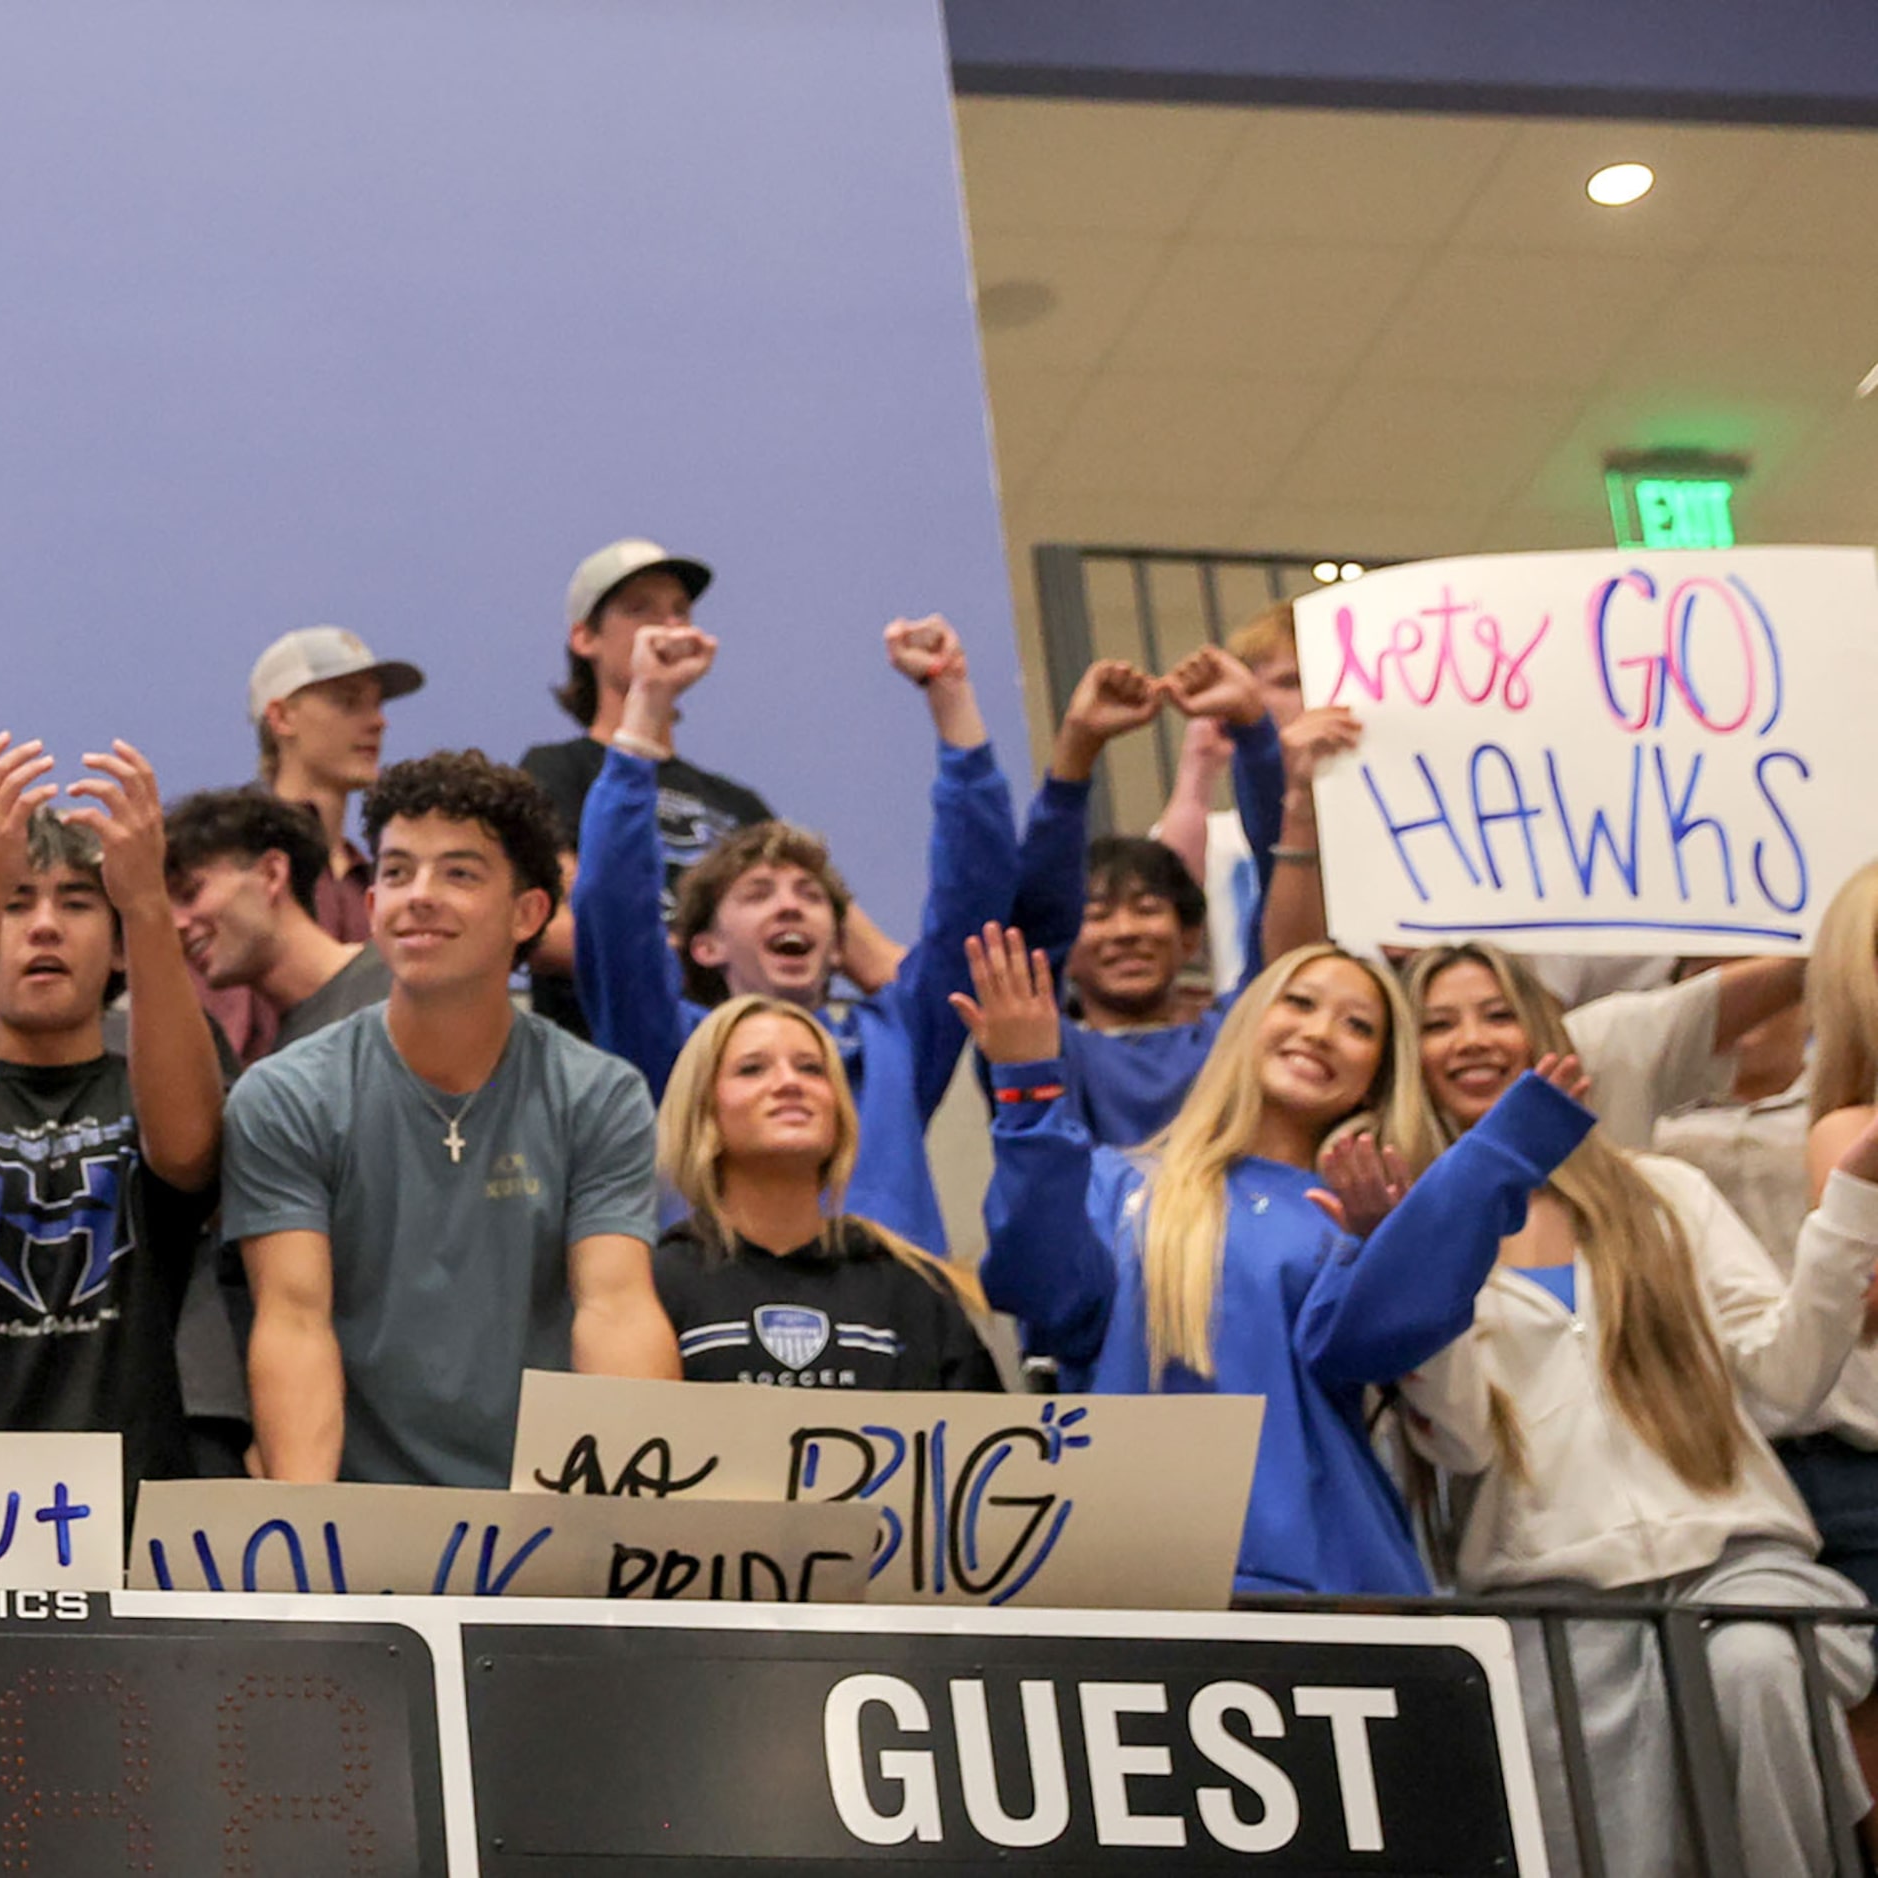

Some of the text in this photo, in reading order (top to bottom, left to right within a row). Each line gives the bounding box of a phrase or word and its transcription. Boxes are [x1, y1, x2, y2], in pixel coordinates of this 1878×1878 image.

[1362, 743, 1810, 914] HAWKS
[737, 1368, 857, 1387] SOCCER
[823, 1672, 1400, 1853] GUEST
